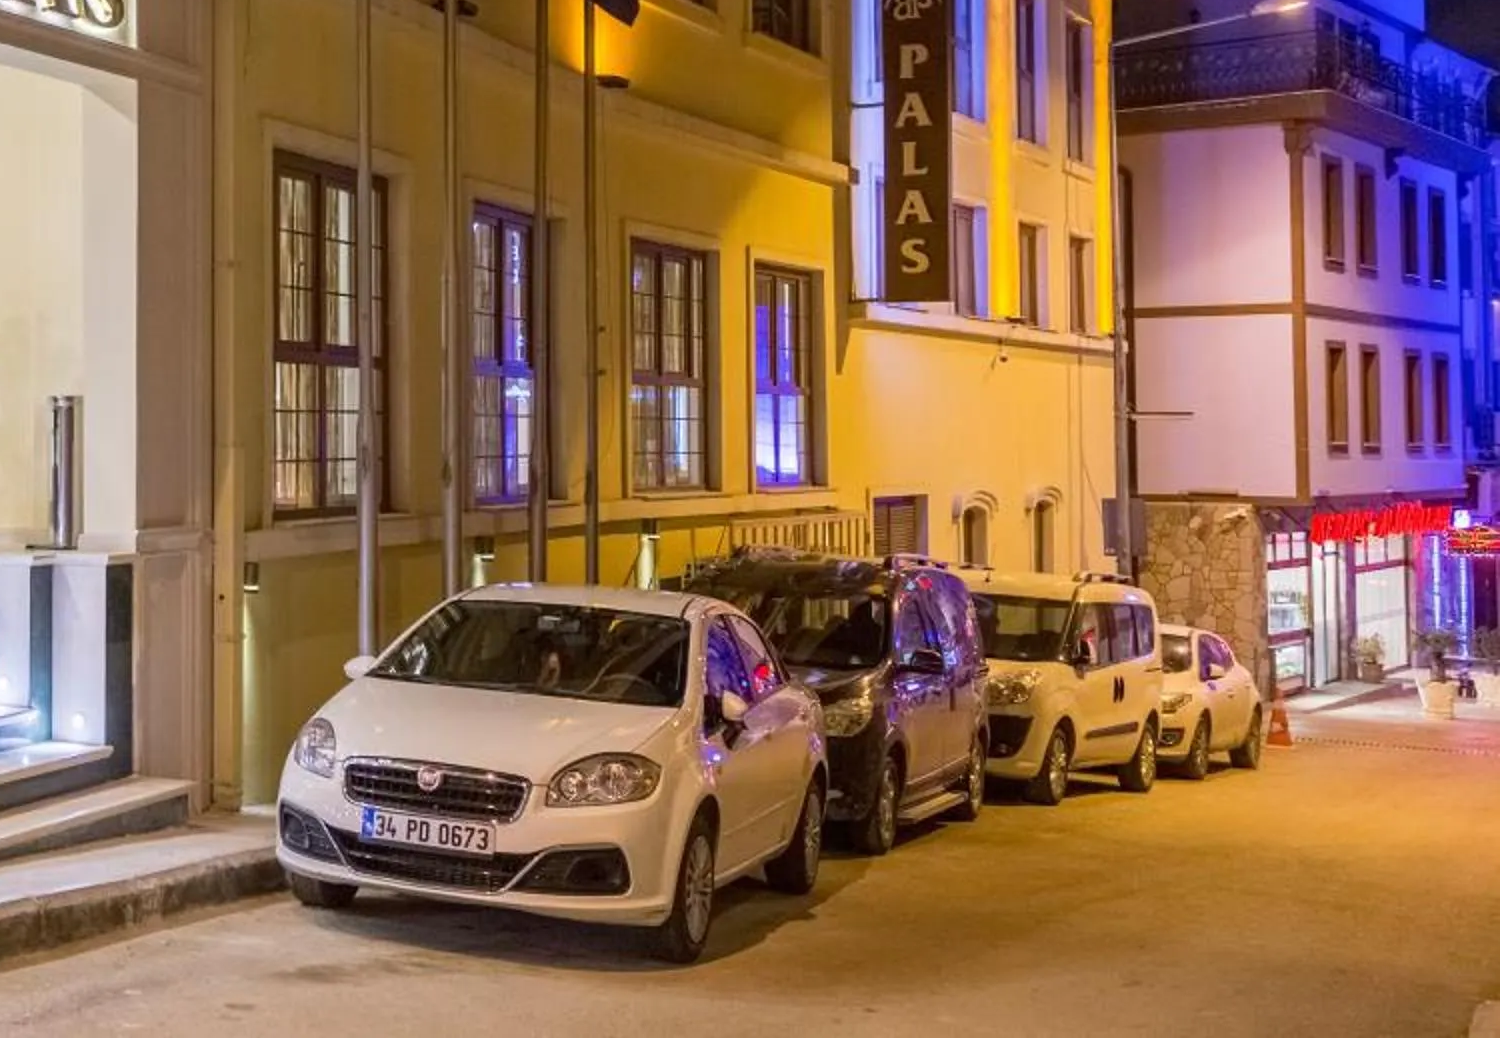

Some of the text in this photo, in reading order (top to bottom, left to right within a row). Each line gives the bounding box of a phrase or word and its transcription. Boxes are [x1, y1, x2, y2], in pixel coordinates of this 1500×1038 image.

[895, 43, 932, 275] PALAS
[375, 815, 397, 838] 34
[406, 819, 430, 842] PD
[438, 823, 489, 850] 0673
